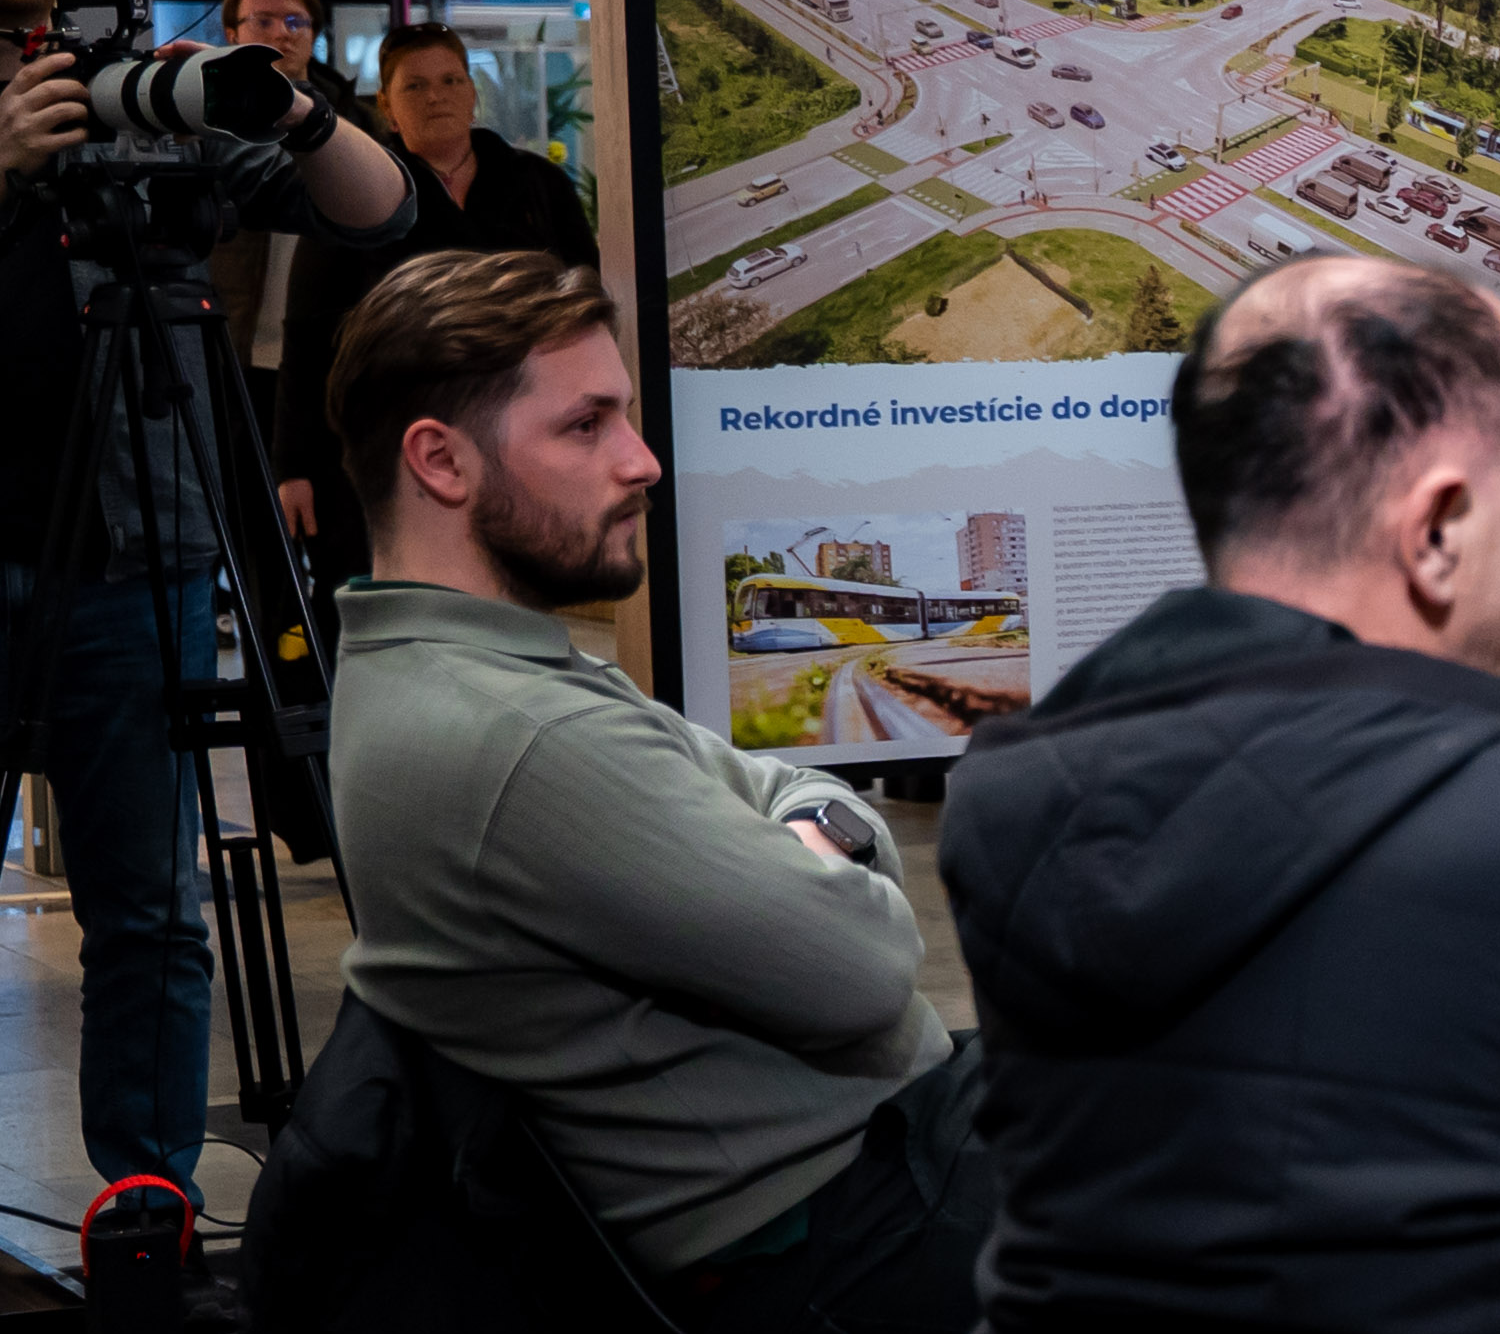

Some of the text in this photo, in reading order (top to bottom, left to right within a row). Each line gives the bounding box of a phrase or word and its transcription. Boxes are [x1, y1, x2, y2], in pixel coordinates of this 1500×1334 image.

[719, 401, 881, 432] Rekordné
[891, 396, 1042, 426] investície
[1051, 396, 1091, 420] do
[1100, 394, 1172, 423] dopr
